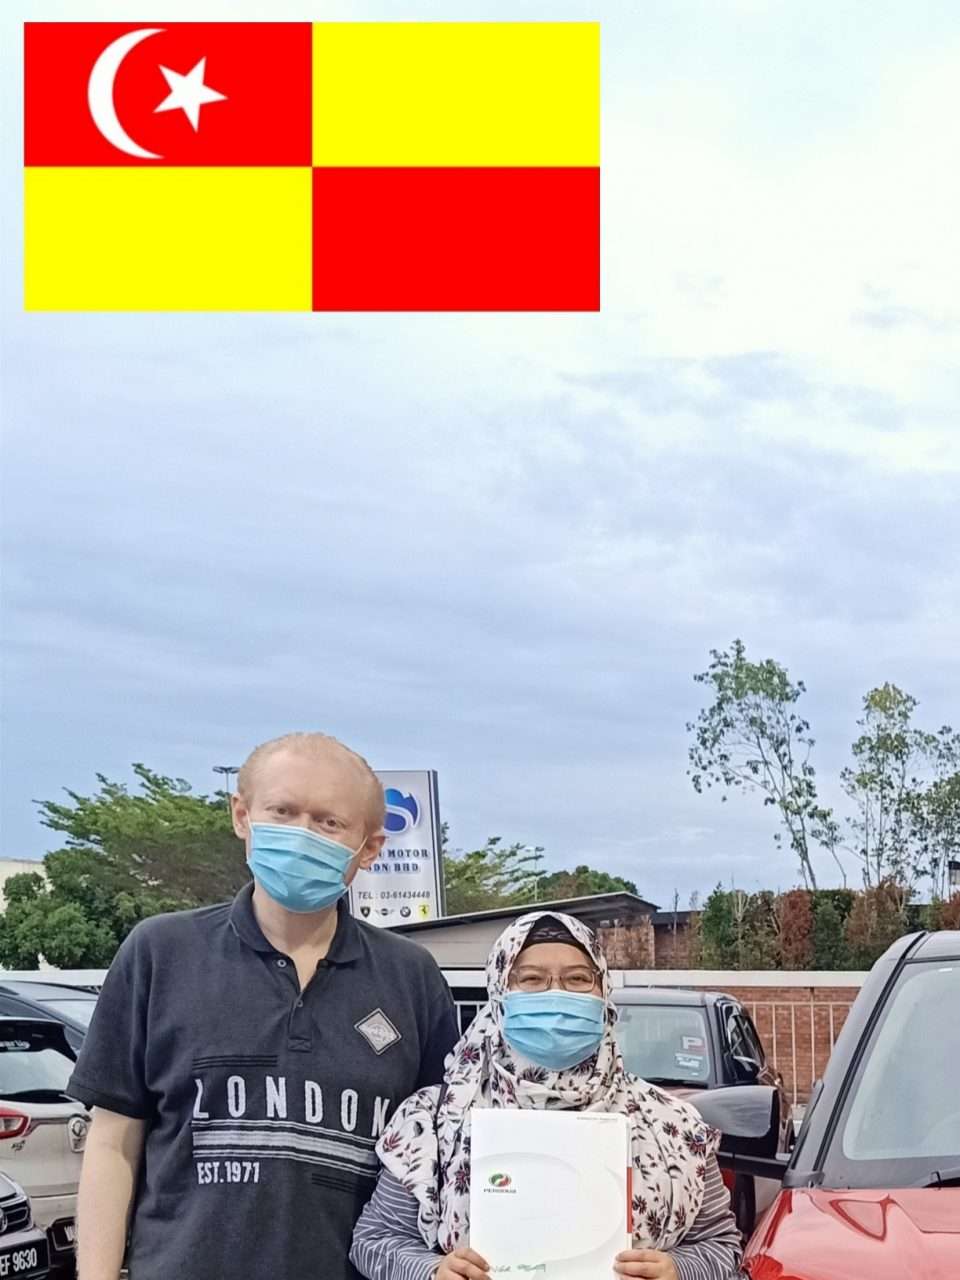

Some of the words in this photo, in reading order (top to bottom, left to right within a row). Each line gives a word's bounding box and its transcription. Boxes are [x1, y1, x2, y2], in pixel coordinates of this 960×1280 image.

[387, 848, 429, 858] MOTOR
[394, 863, 419, 872] BHD
[358, 891, 373, 900] TEL
[193, 1075, 390, 1137] LONDON
[197, 1160, 260, 1185] EST.1971
[12, 1247, 37, 1272] 9630
